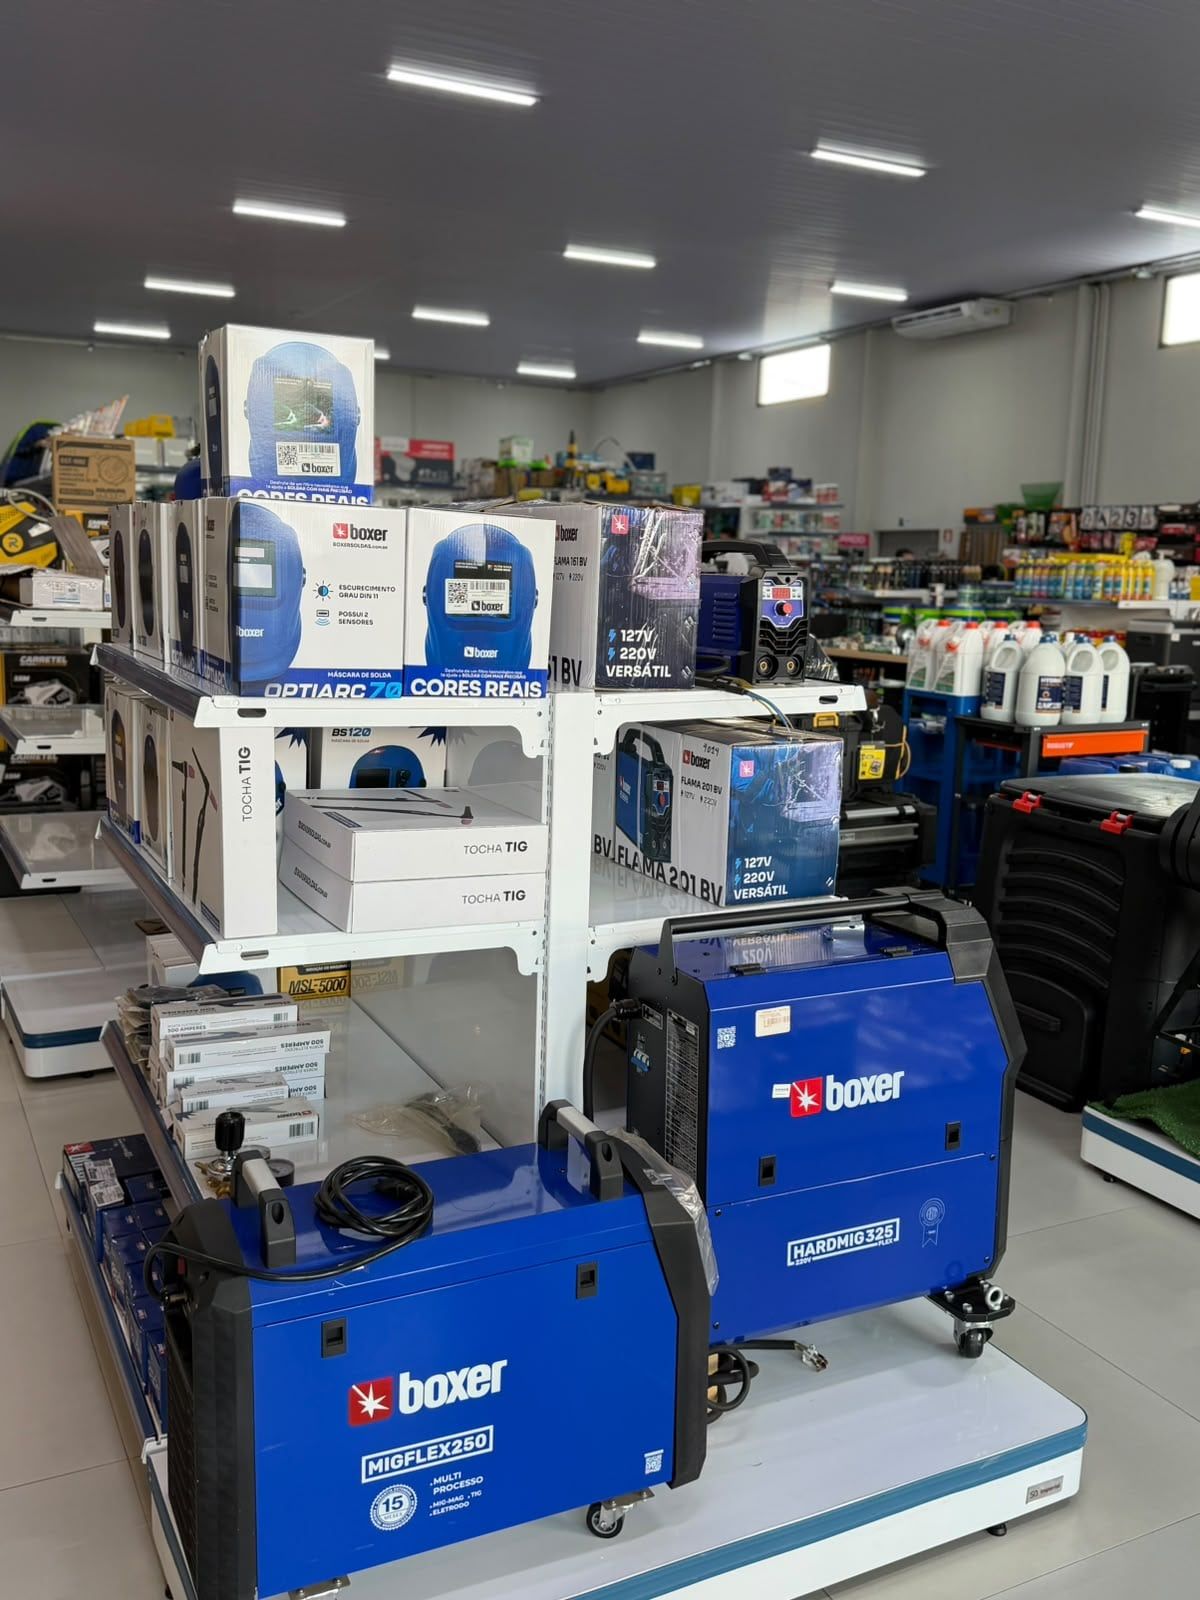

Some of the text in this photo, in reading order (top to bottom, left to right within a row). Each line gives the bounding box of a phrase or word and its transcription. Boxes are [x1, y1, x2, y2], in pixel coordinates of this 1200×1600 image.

[311, 462, 334, 474] boxer
[350, 523, 388, 541] boxer
[560, 525, 579, 542] boxer
[338, 584, 396, 593] ESCURECIMENTO
[481, 600, 504, 612] boxer
[338, 618, 374, 626] SENSORES
[620, 629, 654, 643] 127V
[474, 647, 499, 658] boxer
[619, 647, 657, 661] 220V
[327, 671, 361, 679] MÁSCARA
[561, 657, 583, 687] BV
[605, 662, 672, 678] VERSÁTIL
[264, 682, 367, 699] OPTIARC
[410, 678, 542, 698] CORES REAIS
[691, 751, 711, 770] boxer
[238, 746, 252, 822] TOCHA TIG
[681, 776, 723, 795] FLAMA 201 BV
[463, 840, 529, 856] TOCHA TIG
[594, 834, 613, 859] BV
[744, 856, 773, 869] 127V
[617, 845, 724, 907] FLAMA 201 BV
[743, 871, 775, 884] 220V
[461, 889, 527, 905] TOCHA TIG
[733, 884, 789, 900] VERSÁTIL
[288, 977, 347, 996] MSL-5000
[280, 1040, 311, 1049] AMPERES
[274, 1064, 304, 1073] AMPERES
[825, 1071, 905, 1112] boxer
[878, 1238, 894, 1247] FLEX
[795, 1256, 812, 1266] 220V
[398, 1359, 508, 1415] boxer
[367, 1433, 488, 1476] MIGFLEX250
[432, 1475, 484, 1496] PROCESSO
[382, 1495, 404, 1513] 15
